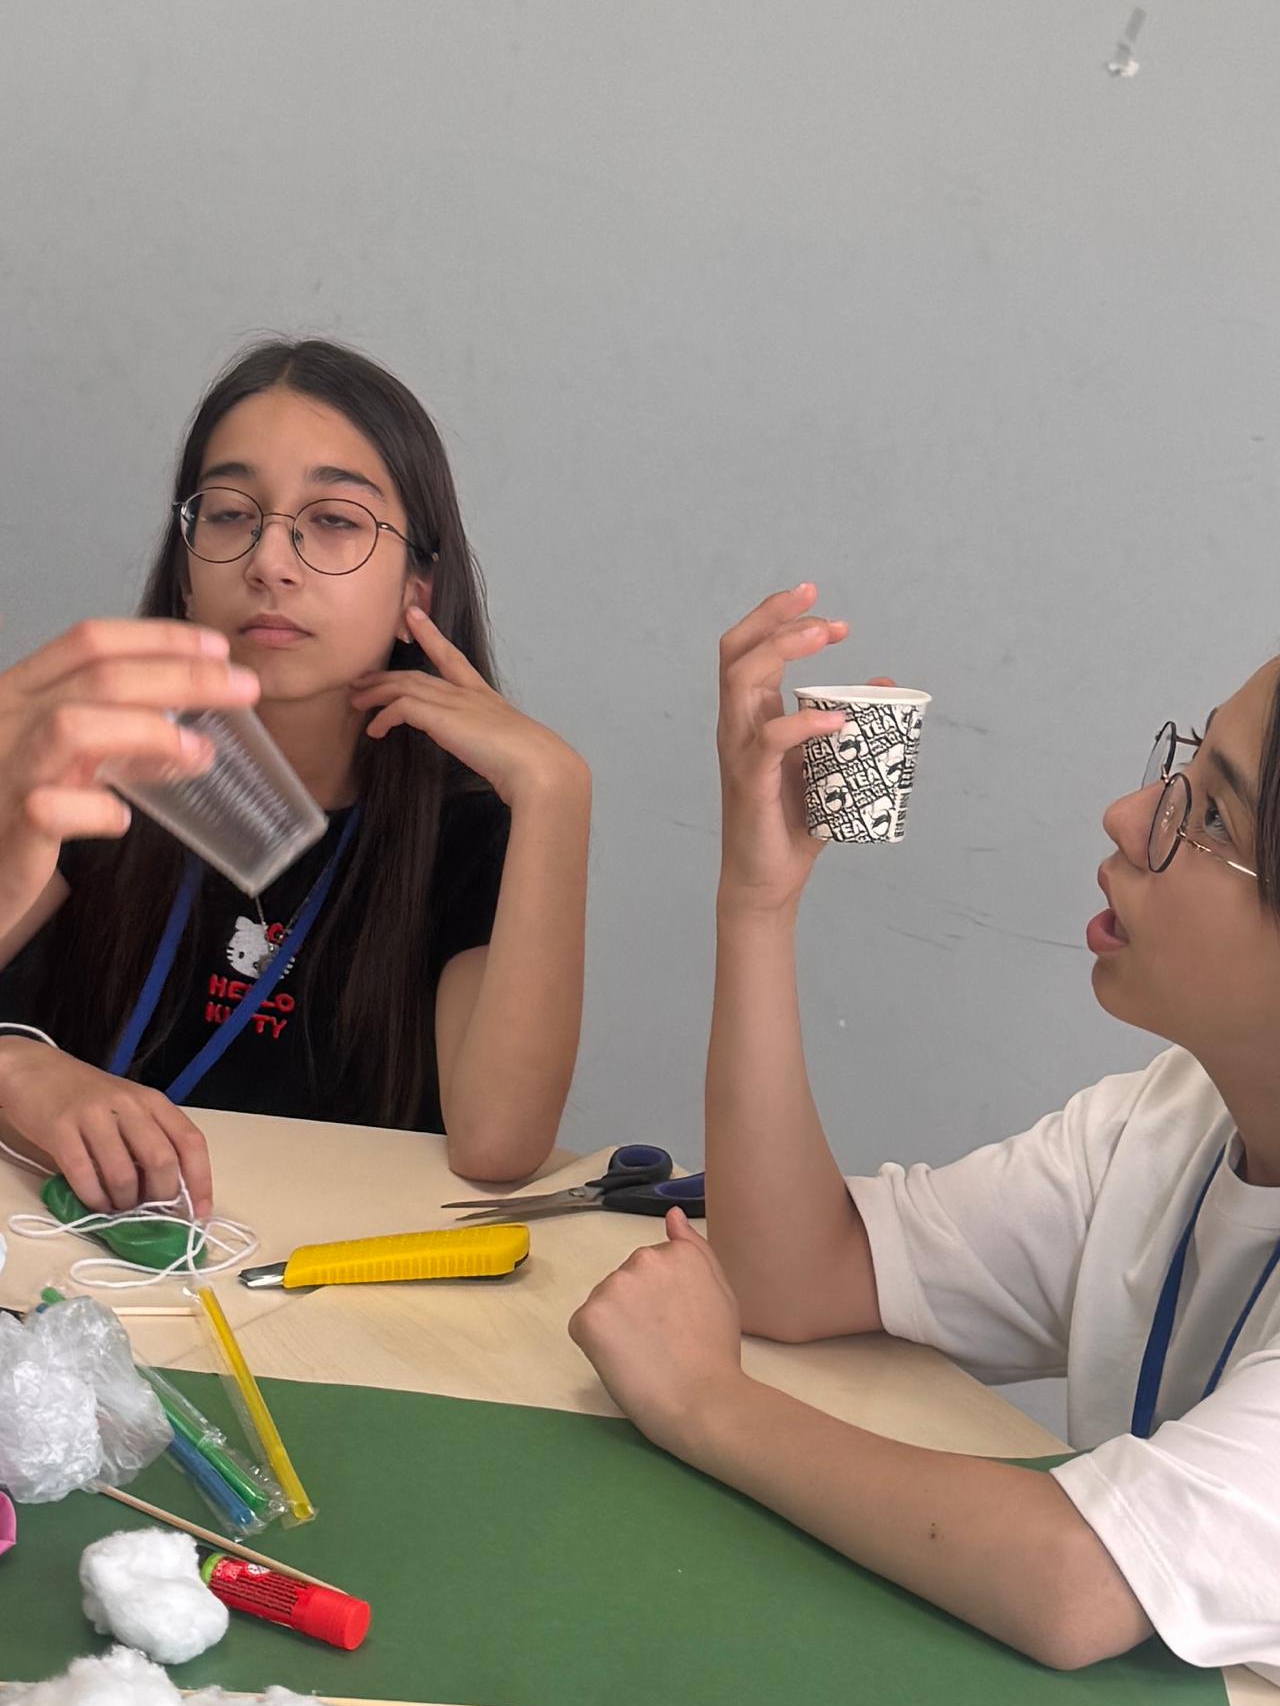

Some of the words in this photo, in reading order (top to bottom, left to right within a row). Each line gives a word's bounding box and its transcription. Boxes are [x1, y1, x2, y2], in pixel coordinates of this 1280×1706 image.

[863, 714, 897, 738] TEA
[846, 766, 883, 791] TEA
[832, 819, 868, 842] TEA
